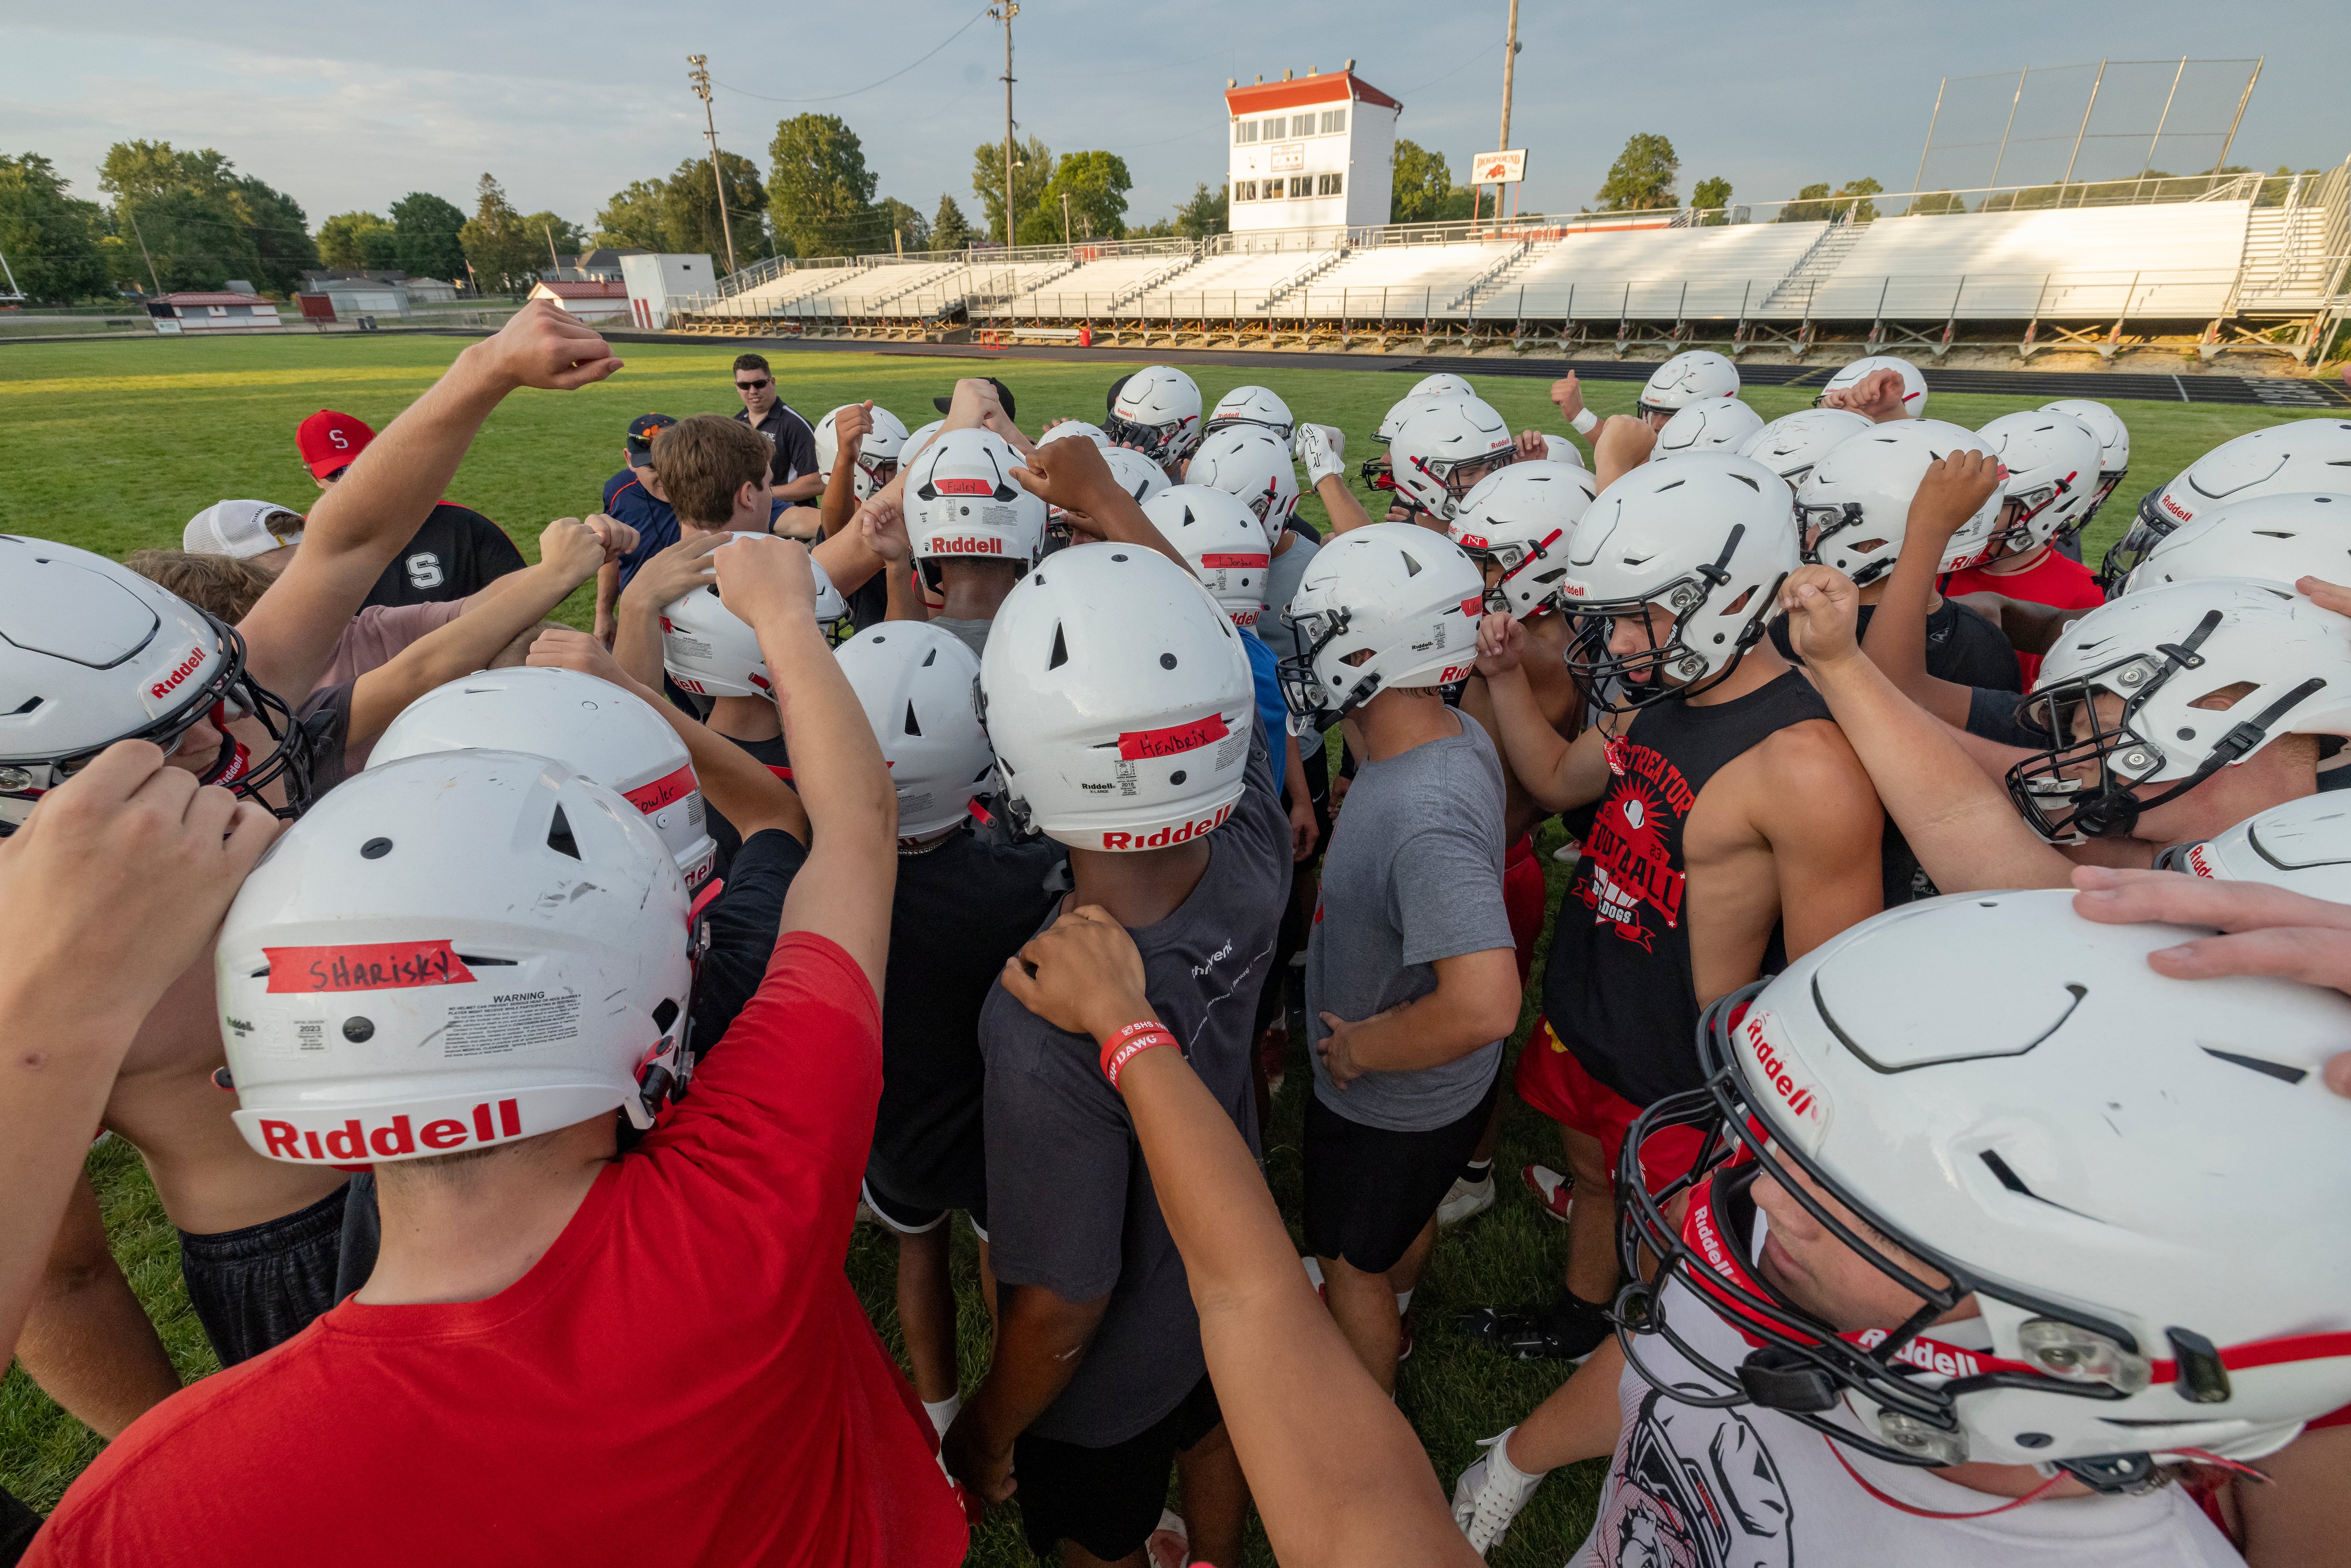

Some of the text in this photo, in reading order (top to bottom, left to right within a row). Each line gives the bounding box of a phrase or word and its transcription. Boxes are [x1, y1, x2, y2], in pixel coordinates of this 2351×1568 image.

[1477, 154, 1520, 168] DOGPOUND
[1117, 408, 1132, 418] Riddell
[330, 429, 349, 449] S
[1491, 437, 1509, 449] Riddell
[2162, 494, 2193, 522] Riddell
[932, 537, 1002, 554] Riddell
[406, 552, 444, 589] S
[1564, 581, 1584, 597] Riddell
[150, 647, 206, 699] Riddell
[1233, 725, 1245, 736] WARNING
[213, 754, 243, 787] Riddell
[1621, 745, 1696, 819] STREATOR
[1102, 803, 1231, 850] Riddell
[1650, 844, 1662, 861] 23
[1232, 967, 1249, 987] Banking
[494, 992, 544, 1003] WARNING
[1134, 1021, 1154, 1030] SHS
[1116, 1035, 1157, 1064] DAWG
[1746, 1013, 1819, 1118] Riddell
[259, 1098, 521, 1159] Riddell
[1695, 1205, 1734, 1276] Riddell
[1859, 1329, 1980, 1378] Rddell
